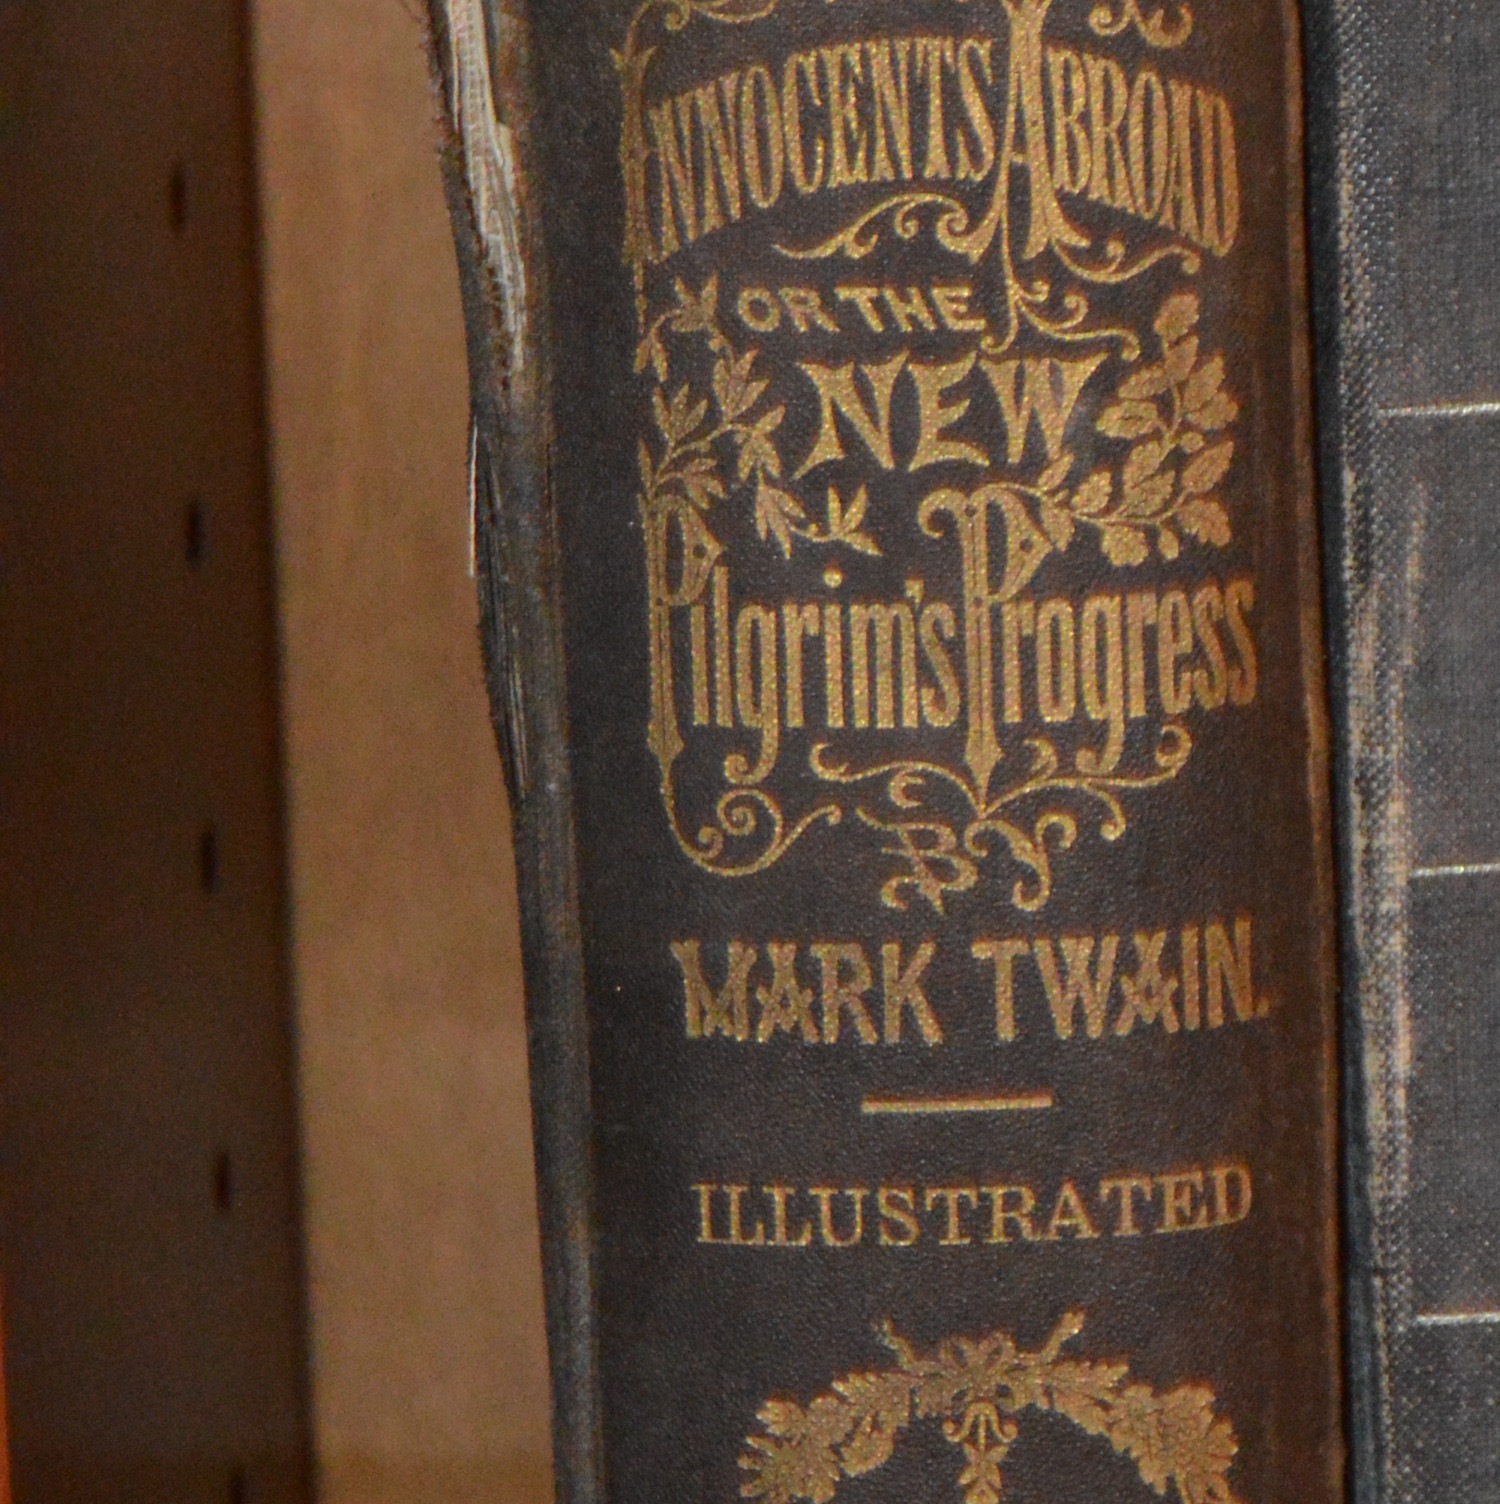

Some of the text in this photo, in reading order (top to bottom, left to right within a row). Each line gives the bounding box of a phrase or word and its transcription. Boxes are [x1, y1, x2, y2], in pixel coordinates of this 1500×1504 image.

[612, 31, 1000, 268] INNOCENTS
[736, 284, 987, 335] OR THE
[792, 351, 1110, 481] NEW
[918, 481, 1259, 816] Progress
[670, 938, 944, 1045] MARK
[690, 1164, 1254, 1248] ILLUSTRATED
